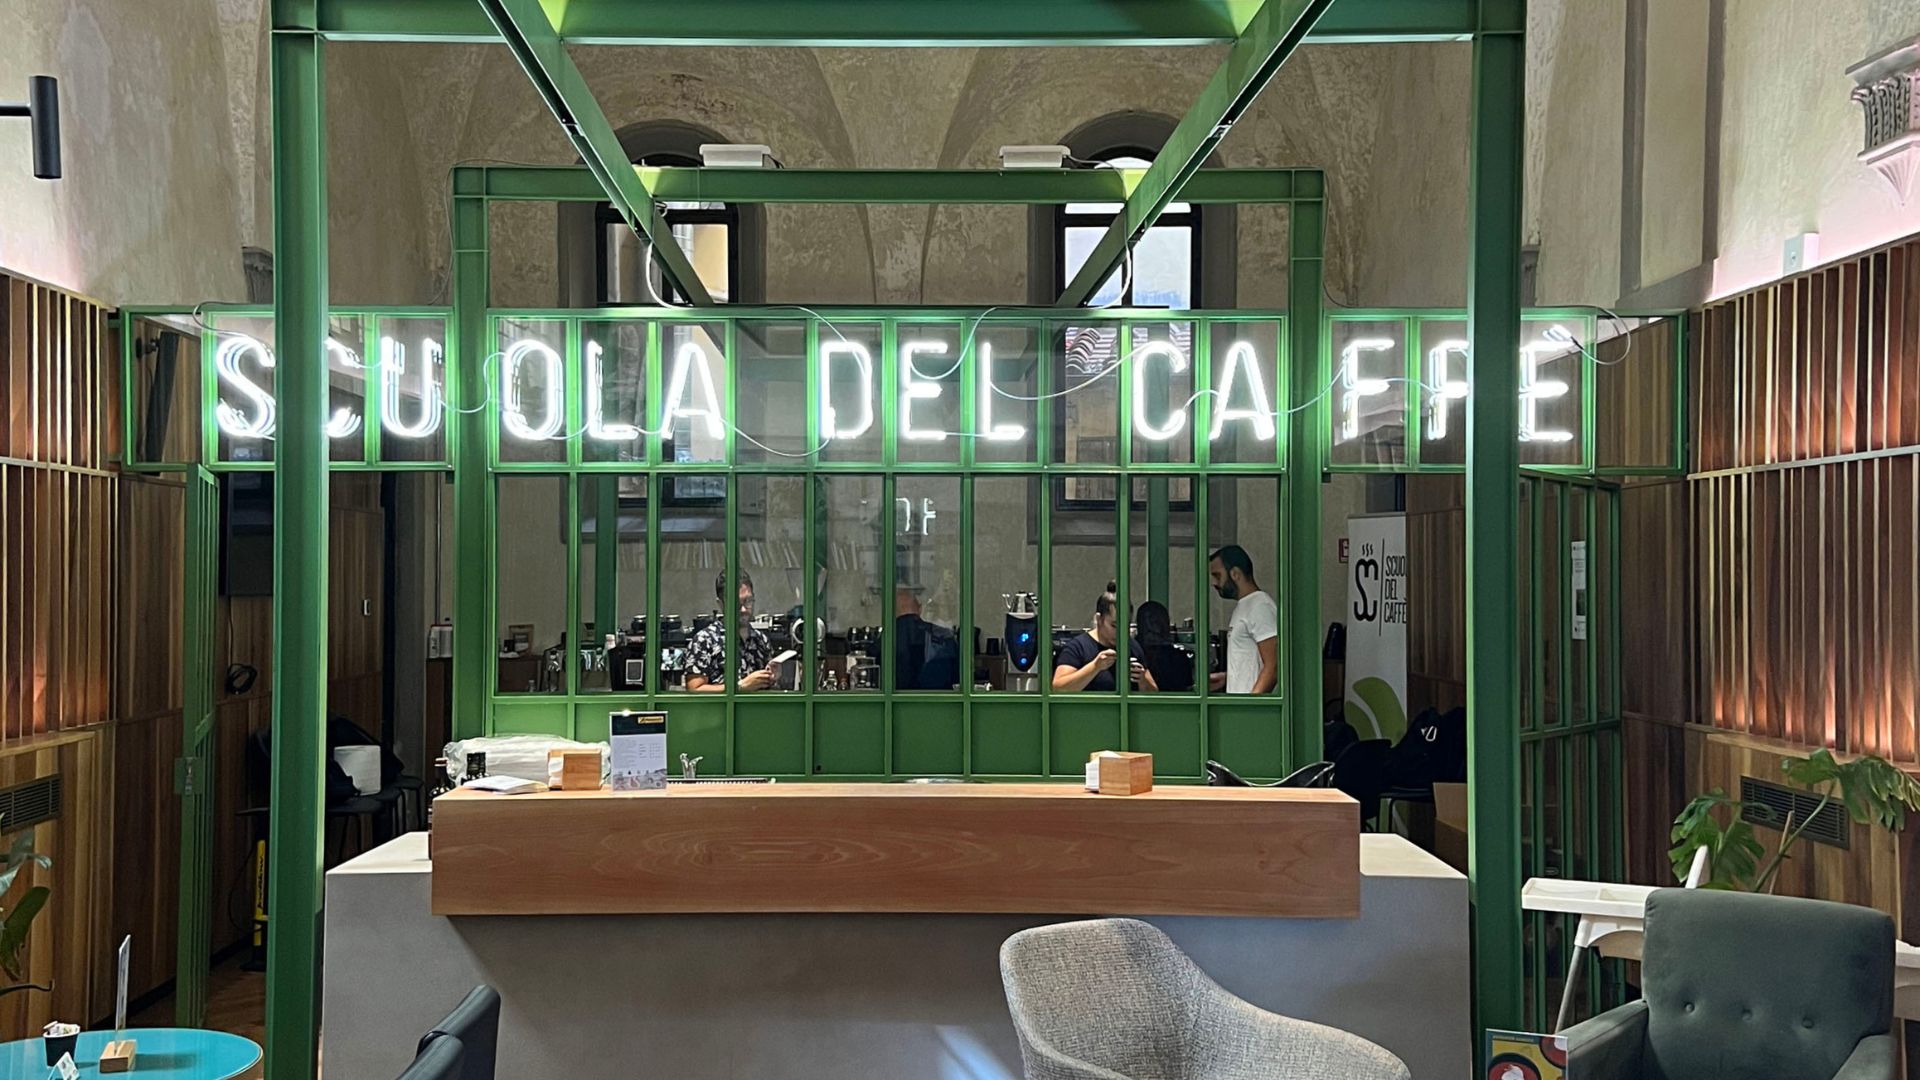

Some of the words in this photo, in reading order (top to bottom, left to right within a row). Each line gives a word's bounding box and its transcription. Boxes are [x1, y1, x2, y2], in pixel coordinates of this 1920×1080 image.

[820, 341, 1026, 440] DEL
[1385, 555, 1408, 577] SCUO
[1385, 578, 1398, 600] DEL
